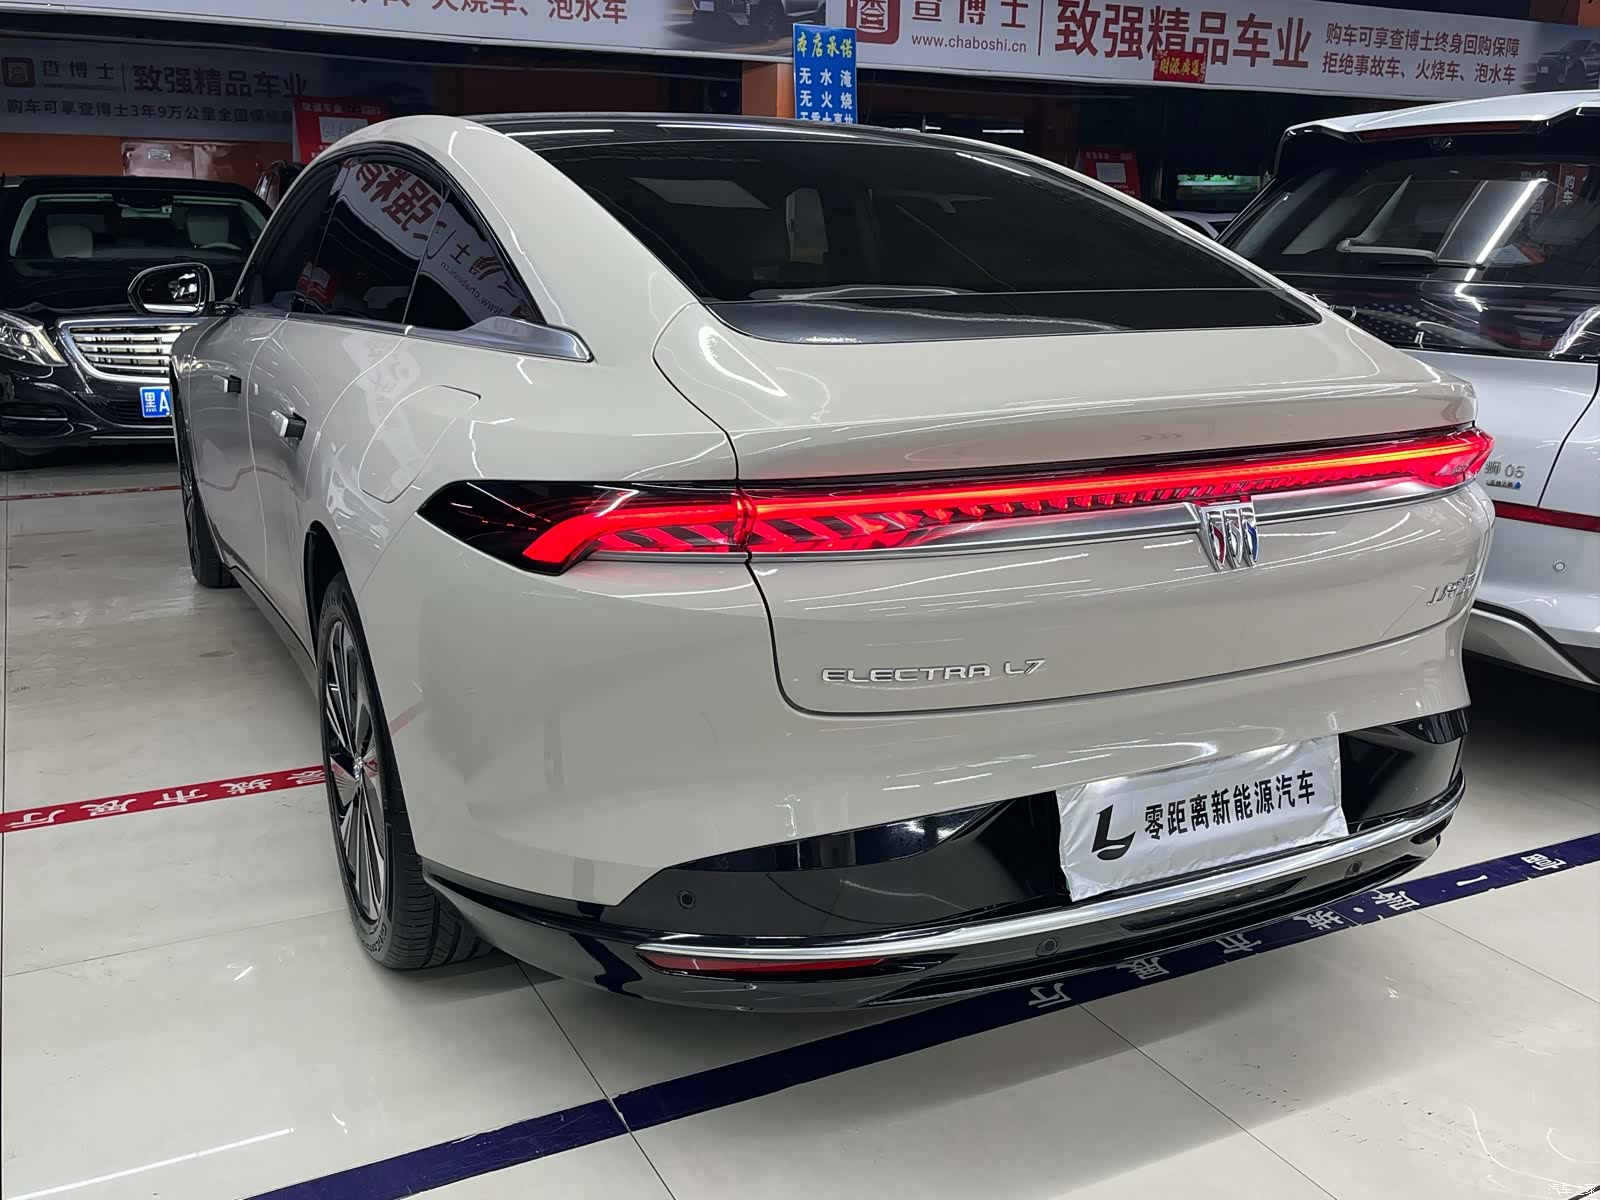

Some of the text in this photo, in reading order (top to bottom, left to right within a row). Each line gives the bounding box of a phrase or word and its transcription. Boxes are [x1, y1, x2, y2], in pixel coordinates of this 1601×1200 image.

[796, 31, 853, 59] 本店承诺
[911, 34, 1028, 53] www.chaboshi.cn
[1054, 0, 1312, 69] 致强精品车业
[1325, 22, 1521, 59] 购车可享查博士终身回购保障
[132, 64, 308, 98] 致强精品车业
[799, 67, 853, 88] 无水淹
[1321, 52, 1517, 85] 拒绝事故车、火烧车、泡水车
[800, 90, 853, 110] 无火烧
[144, 391, 170, 412] 黑A
[822, 659, 1046, 682] ELECTRA L7
[1143, 770, 1316, 840] 零距离新能源汽车
